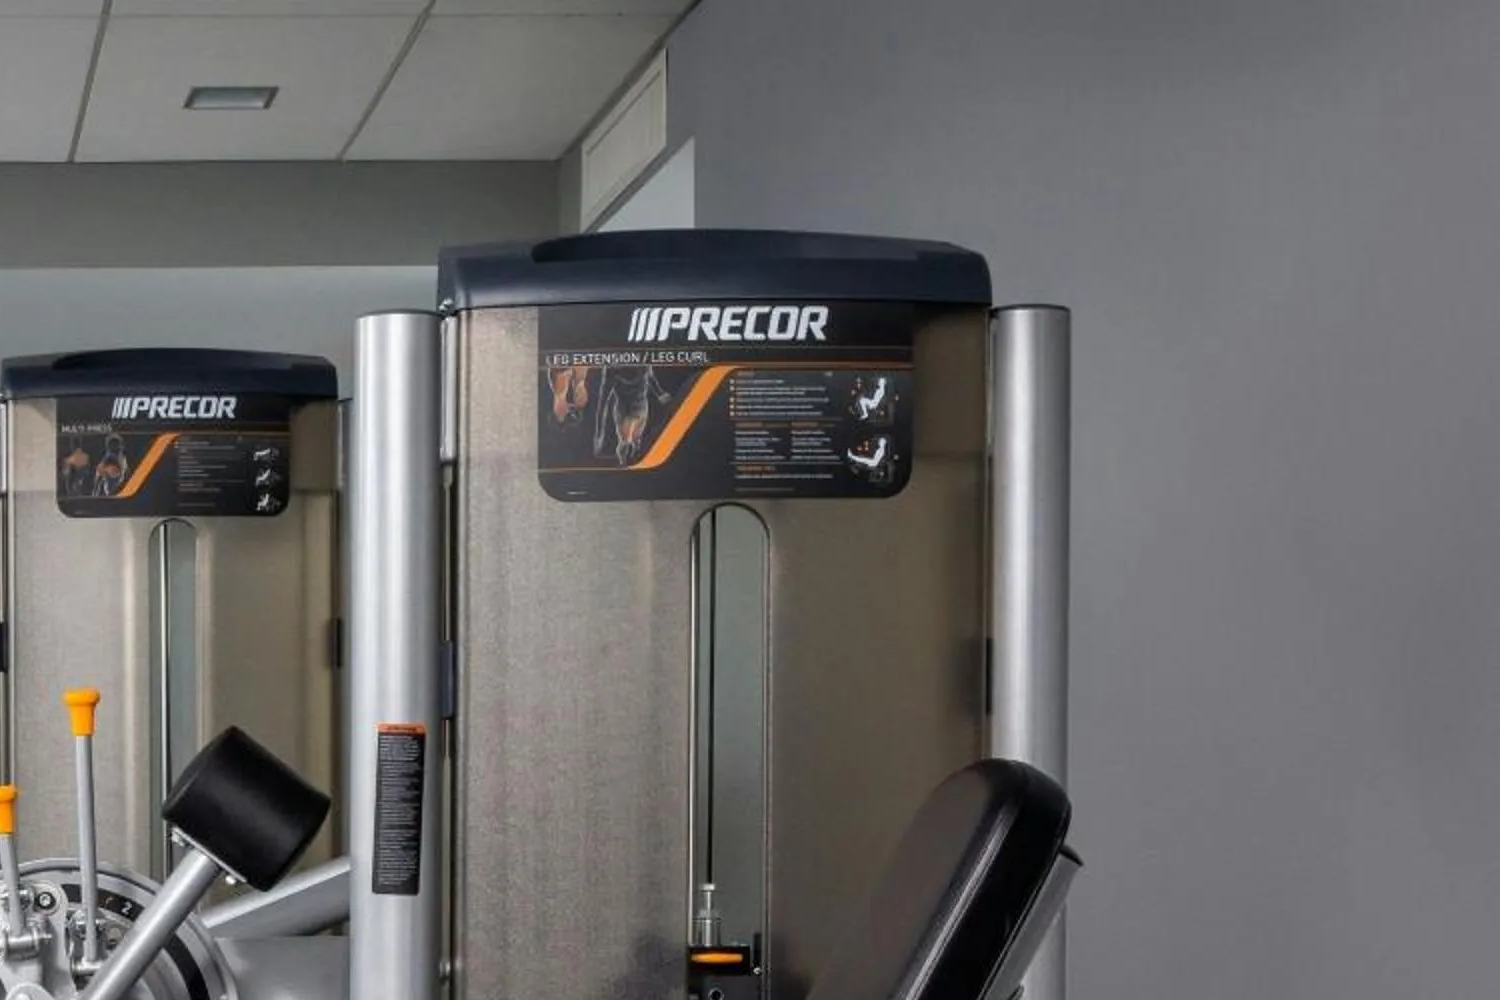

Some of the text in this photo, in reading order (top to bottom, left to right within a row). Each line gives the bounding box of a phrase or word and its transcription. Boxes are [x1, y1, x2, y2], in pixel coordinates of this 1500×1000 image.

[657, 305, 830, 342] PRECOR
[573, 351, 638, 366] EXTENSION
[651, 351, 676, 364] LEG
[677, 351, 710, 364] CURL
[129, 395, 238, 419] PRECOR
